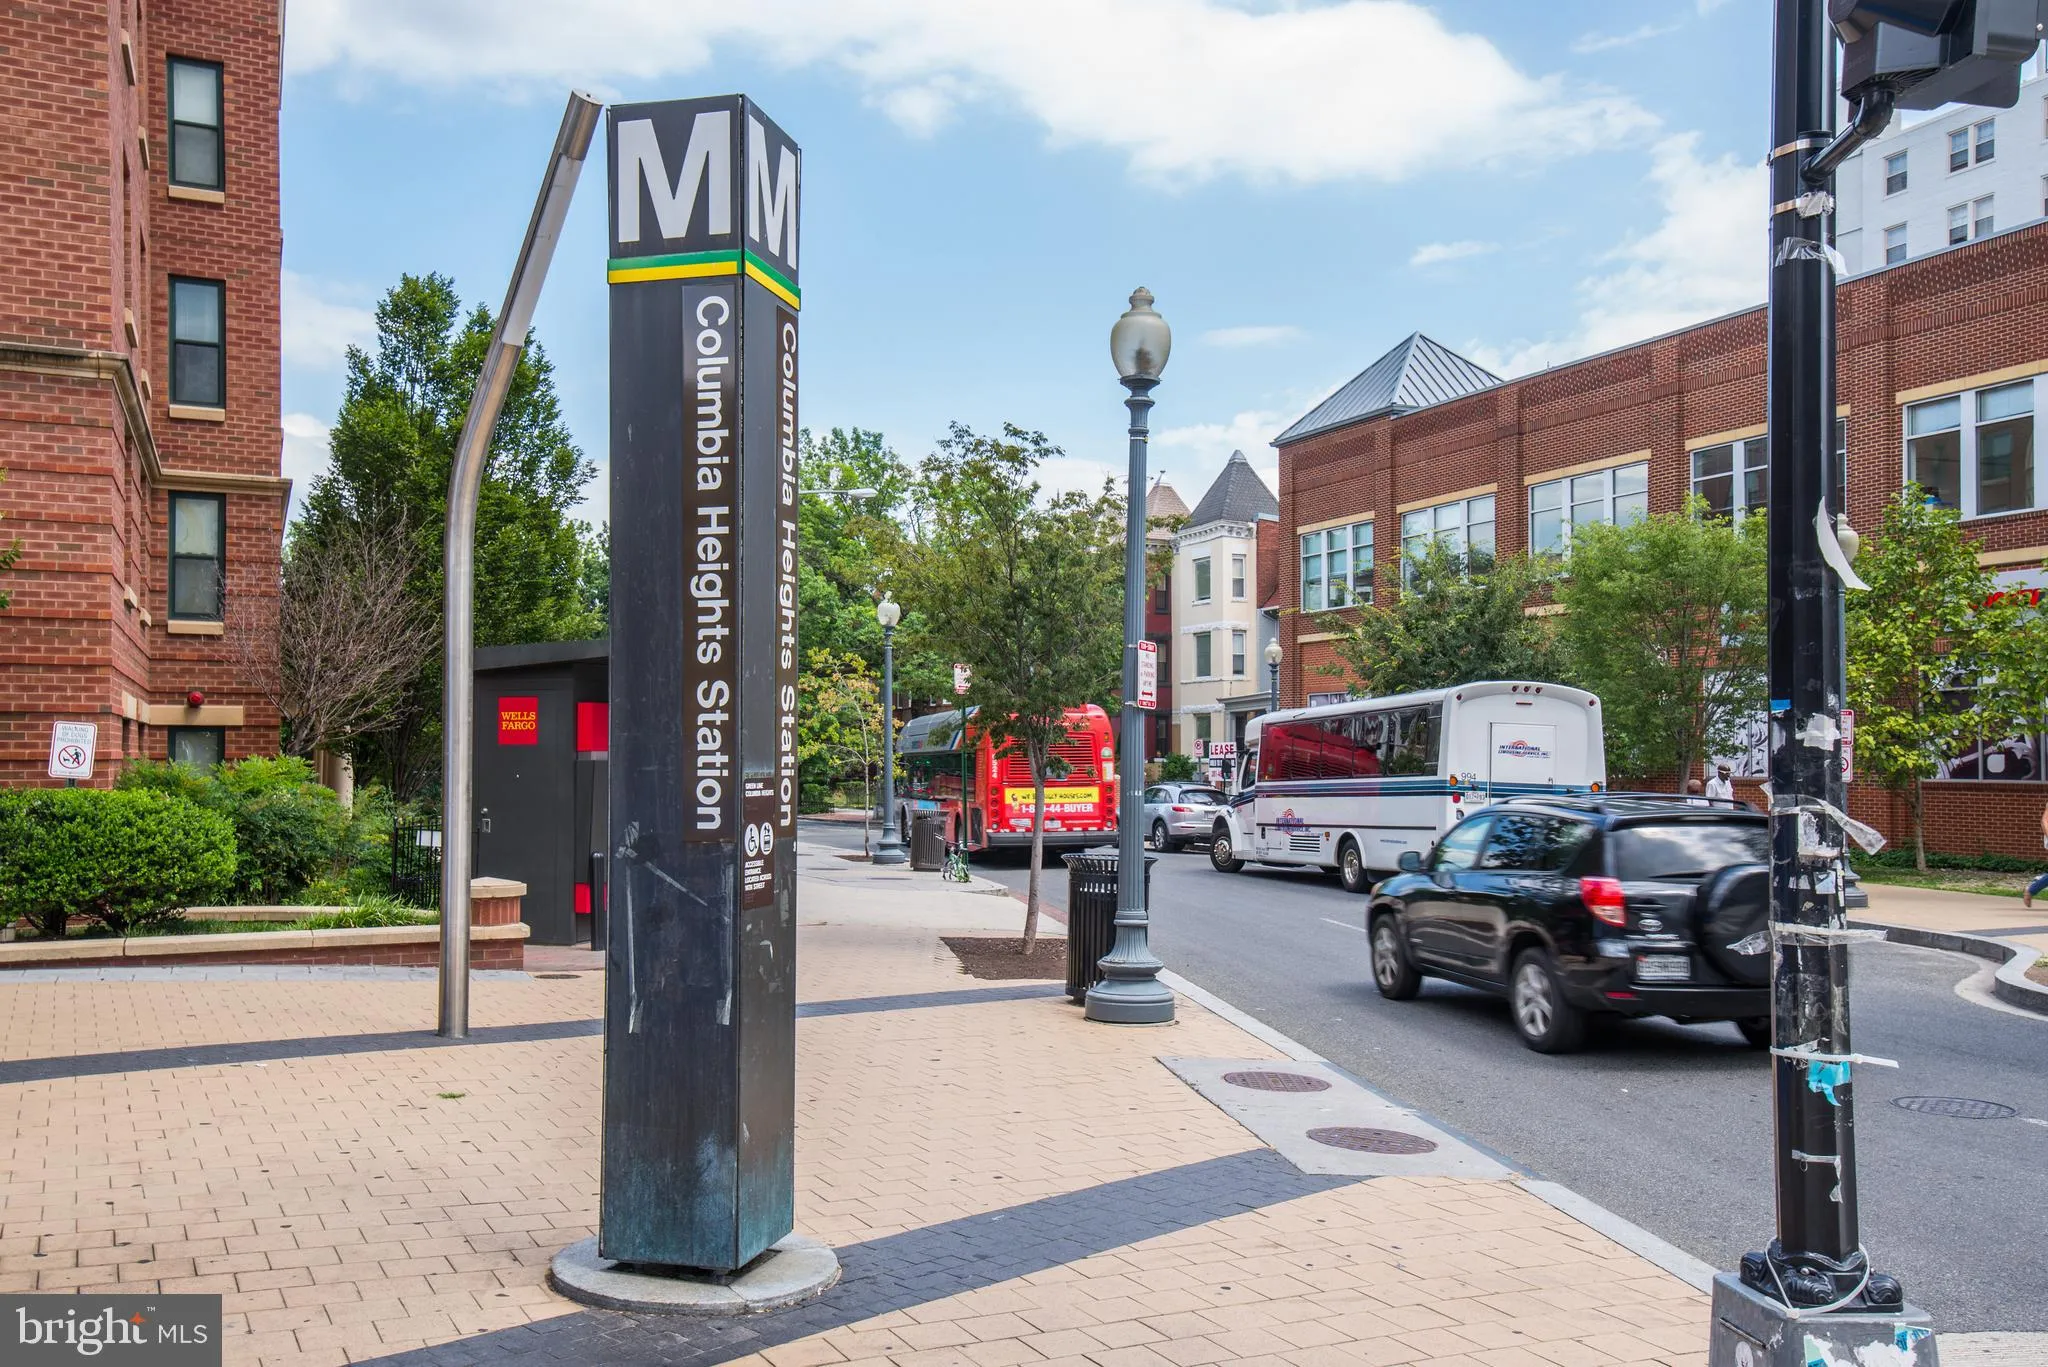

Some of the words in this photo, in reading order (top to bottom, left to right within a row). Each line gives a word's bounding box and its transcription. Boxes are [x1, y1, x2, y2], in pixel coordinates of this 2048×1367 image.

[617, 110, 731, 243] M
[748, 114, 797, 271] M
[695, 295, 730, 491] Columbia
[781, 321, 797, 506] Columbia
[690, 505, 730, 665] Heights
[778, 519, 797, 671] Heights
[500, 711, 536, 721] WELLS
[501, 721, 536, 730] FARGO
[695, 679, 730, 831] Station
[779, 683, 796, 828] Station
[1210, 744, 1235, 756] LEASE
[1461, 772, 1476, 781] 994
[1021, 803, 1094, 814] 1-8-44-BUYER
